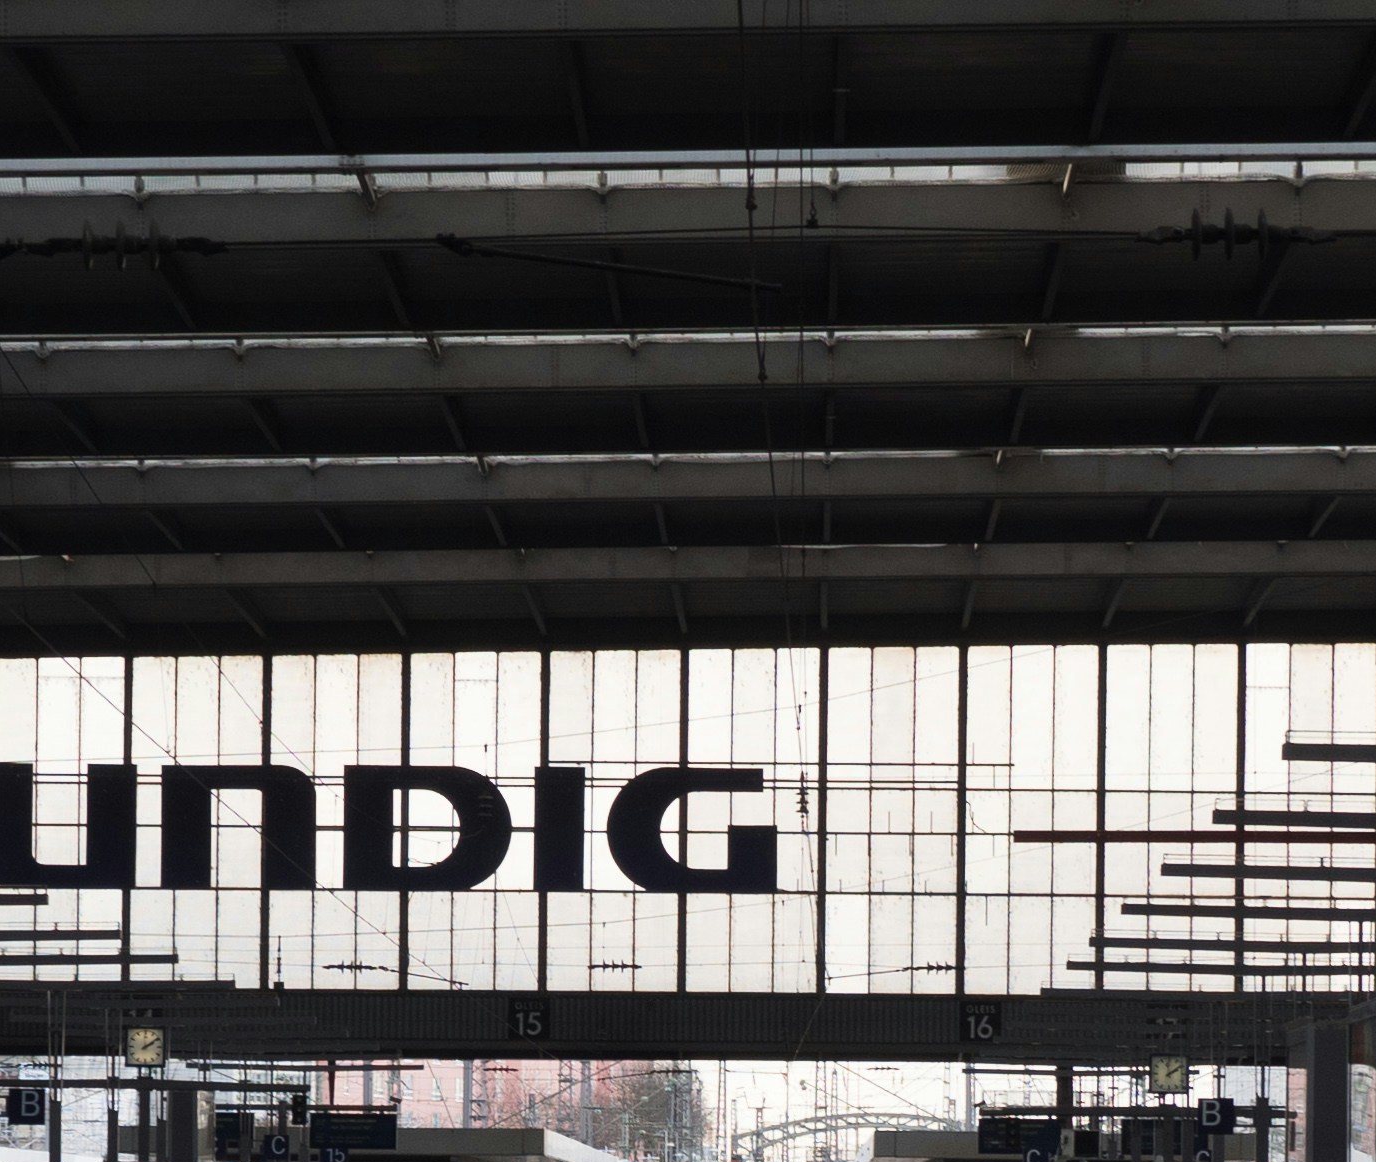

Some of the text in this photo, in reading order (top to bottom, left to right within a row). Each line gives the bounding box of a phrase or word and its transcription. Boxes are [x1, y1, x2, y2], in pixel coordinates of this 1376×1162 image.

[965, 1004, 996, 1014] GLEIS
[515, 1011, 543, 1036] 15
[966, 1014, 993, 1039] 16
[20, 1090, 41, 1117] B
[1201, 1100, 1222, 1127] B
[271, 1135, 286, 1155] C
